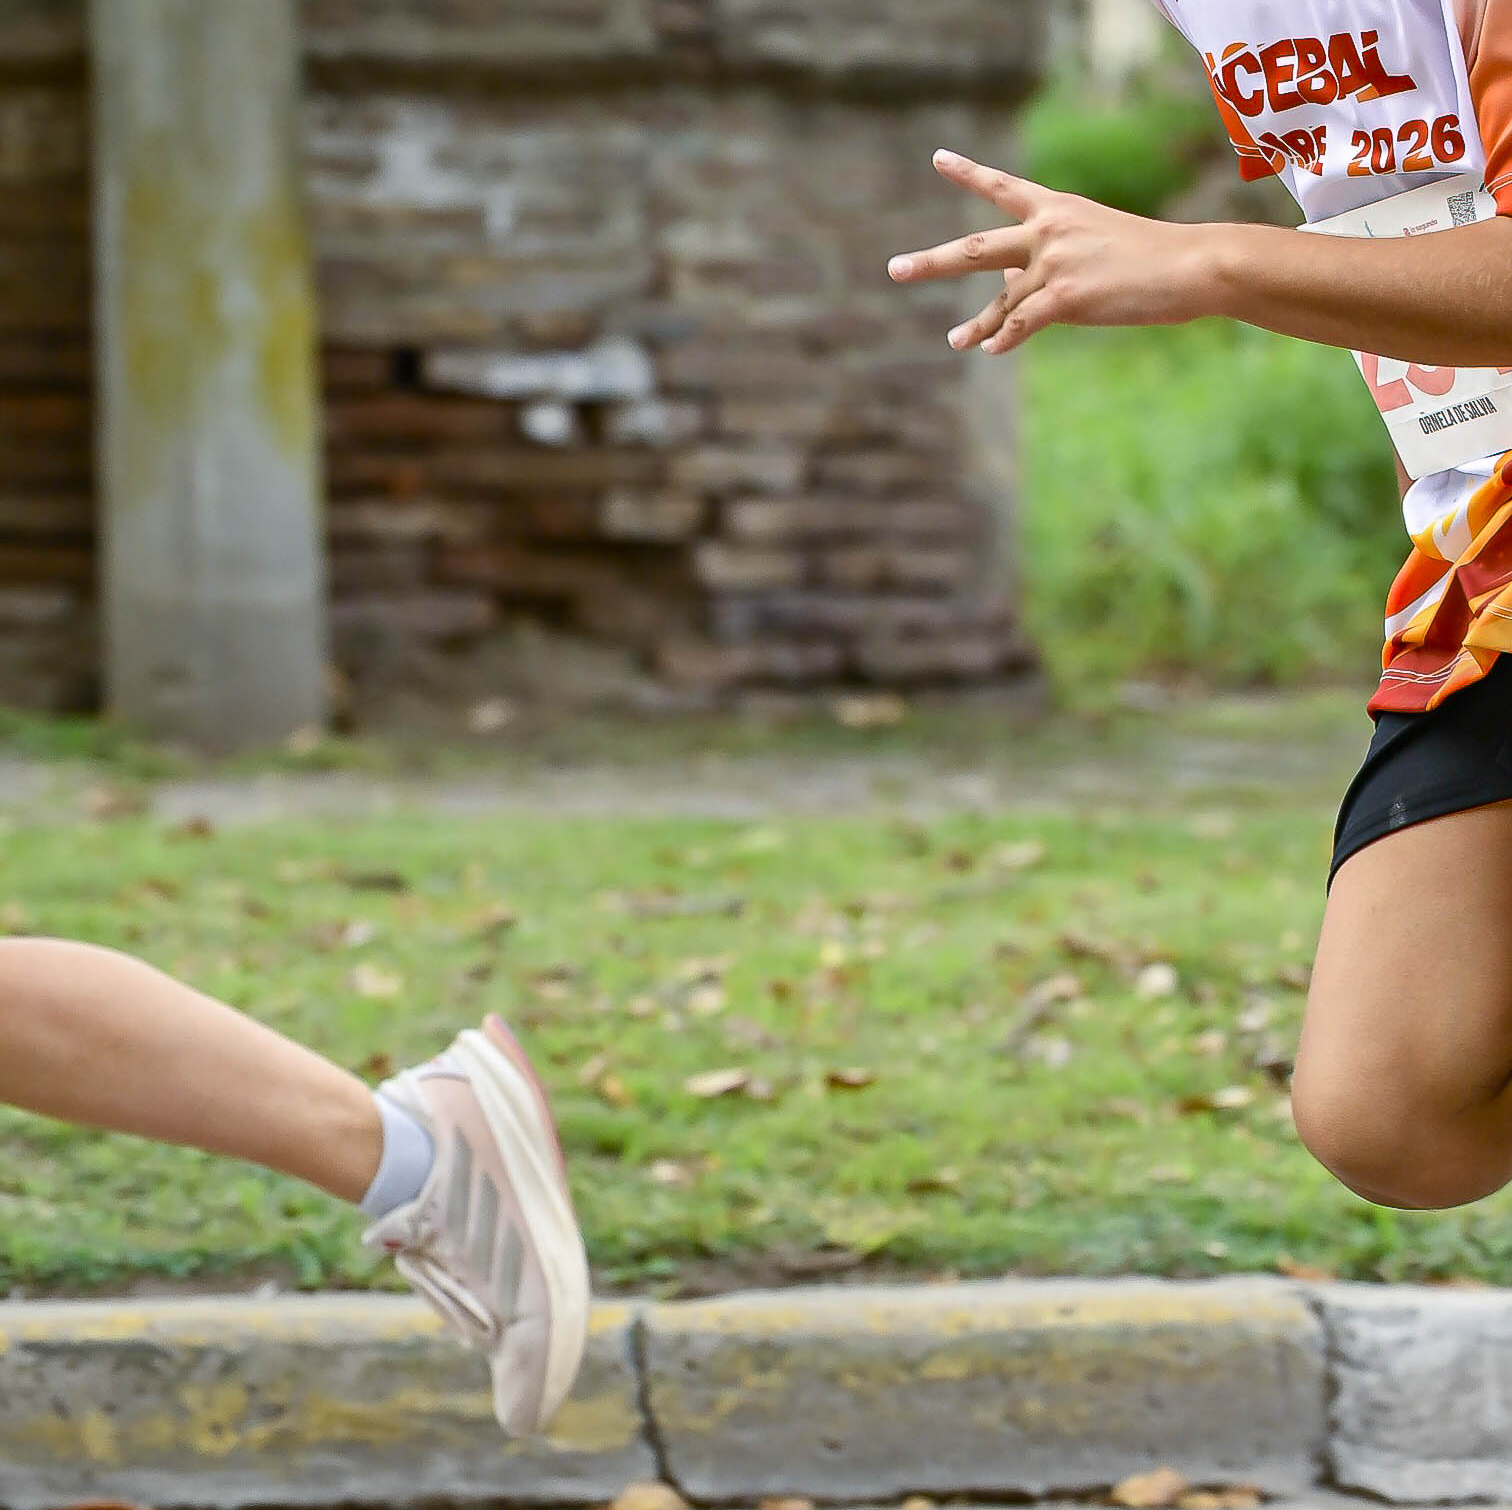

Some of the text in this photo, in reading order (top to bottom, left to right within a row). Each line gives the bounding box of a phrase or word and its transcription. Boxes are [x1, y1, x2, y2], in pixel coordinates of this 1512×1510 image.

[1205, 29, 1417, 117] CEBAL
[1347, 114, 1466, 177] 2026
[1419, 396, 1498, 434] ORNELA DE SALVIA
